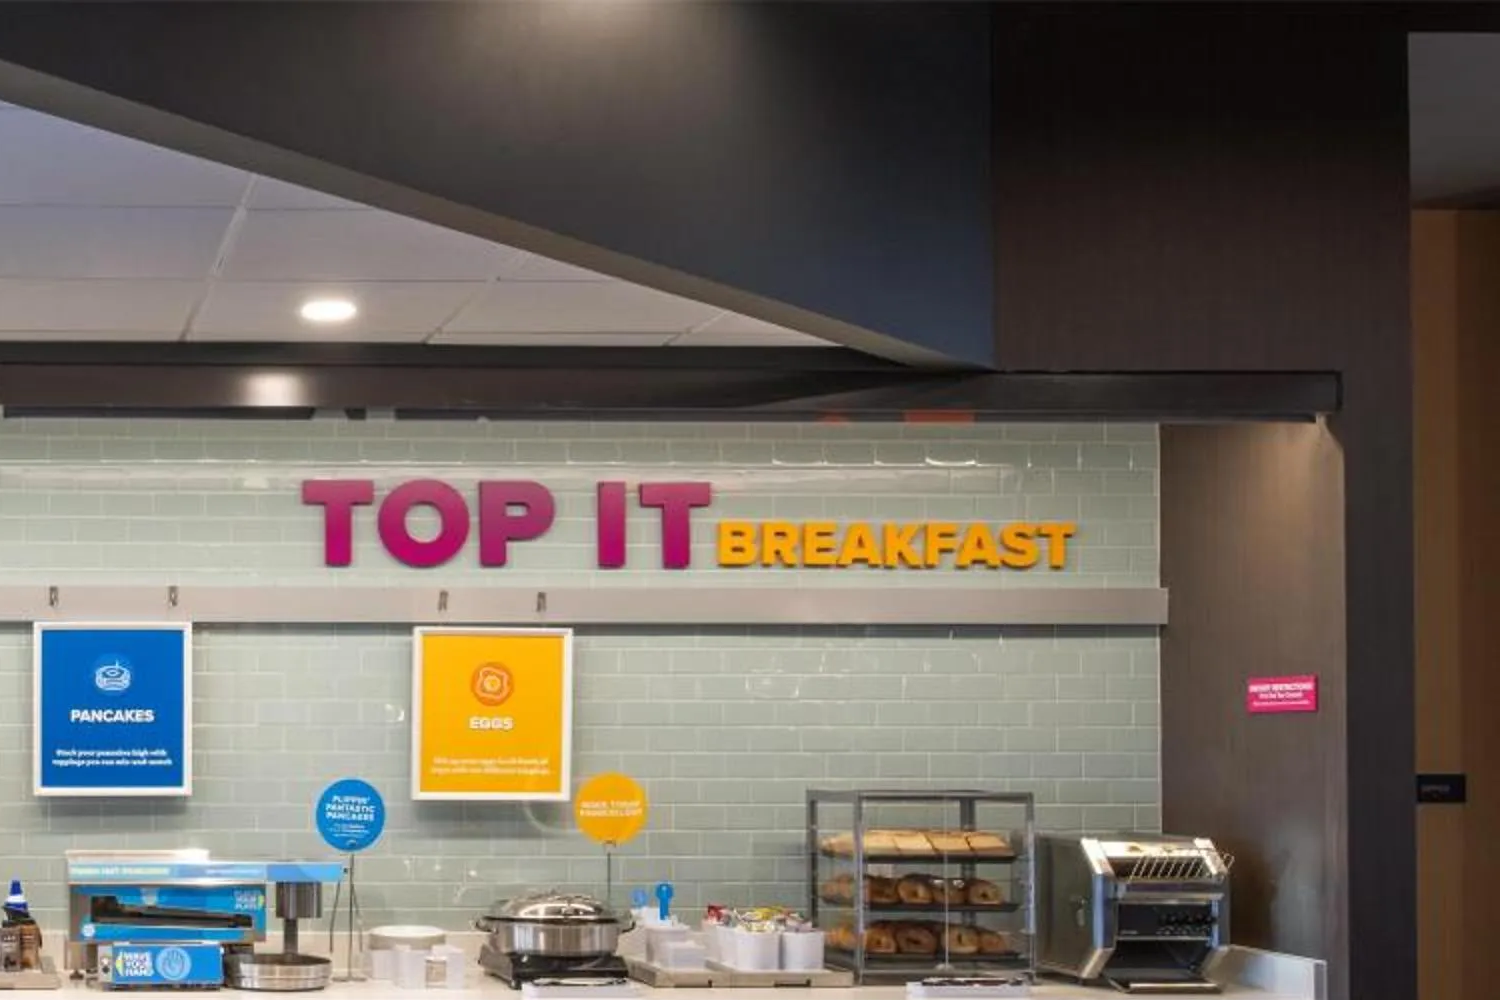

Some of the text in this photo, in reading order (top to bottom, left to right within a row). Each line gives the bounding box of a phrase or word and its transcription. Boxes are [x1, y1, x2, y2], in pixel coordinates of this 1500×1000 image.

[302, 479, 1076, 569] TOP IT BREAKFAST
[70, 709, 155, 722] PANCAKES
[469, 716, 514, 729] EGGS
